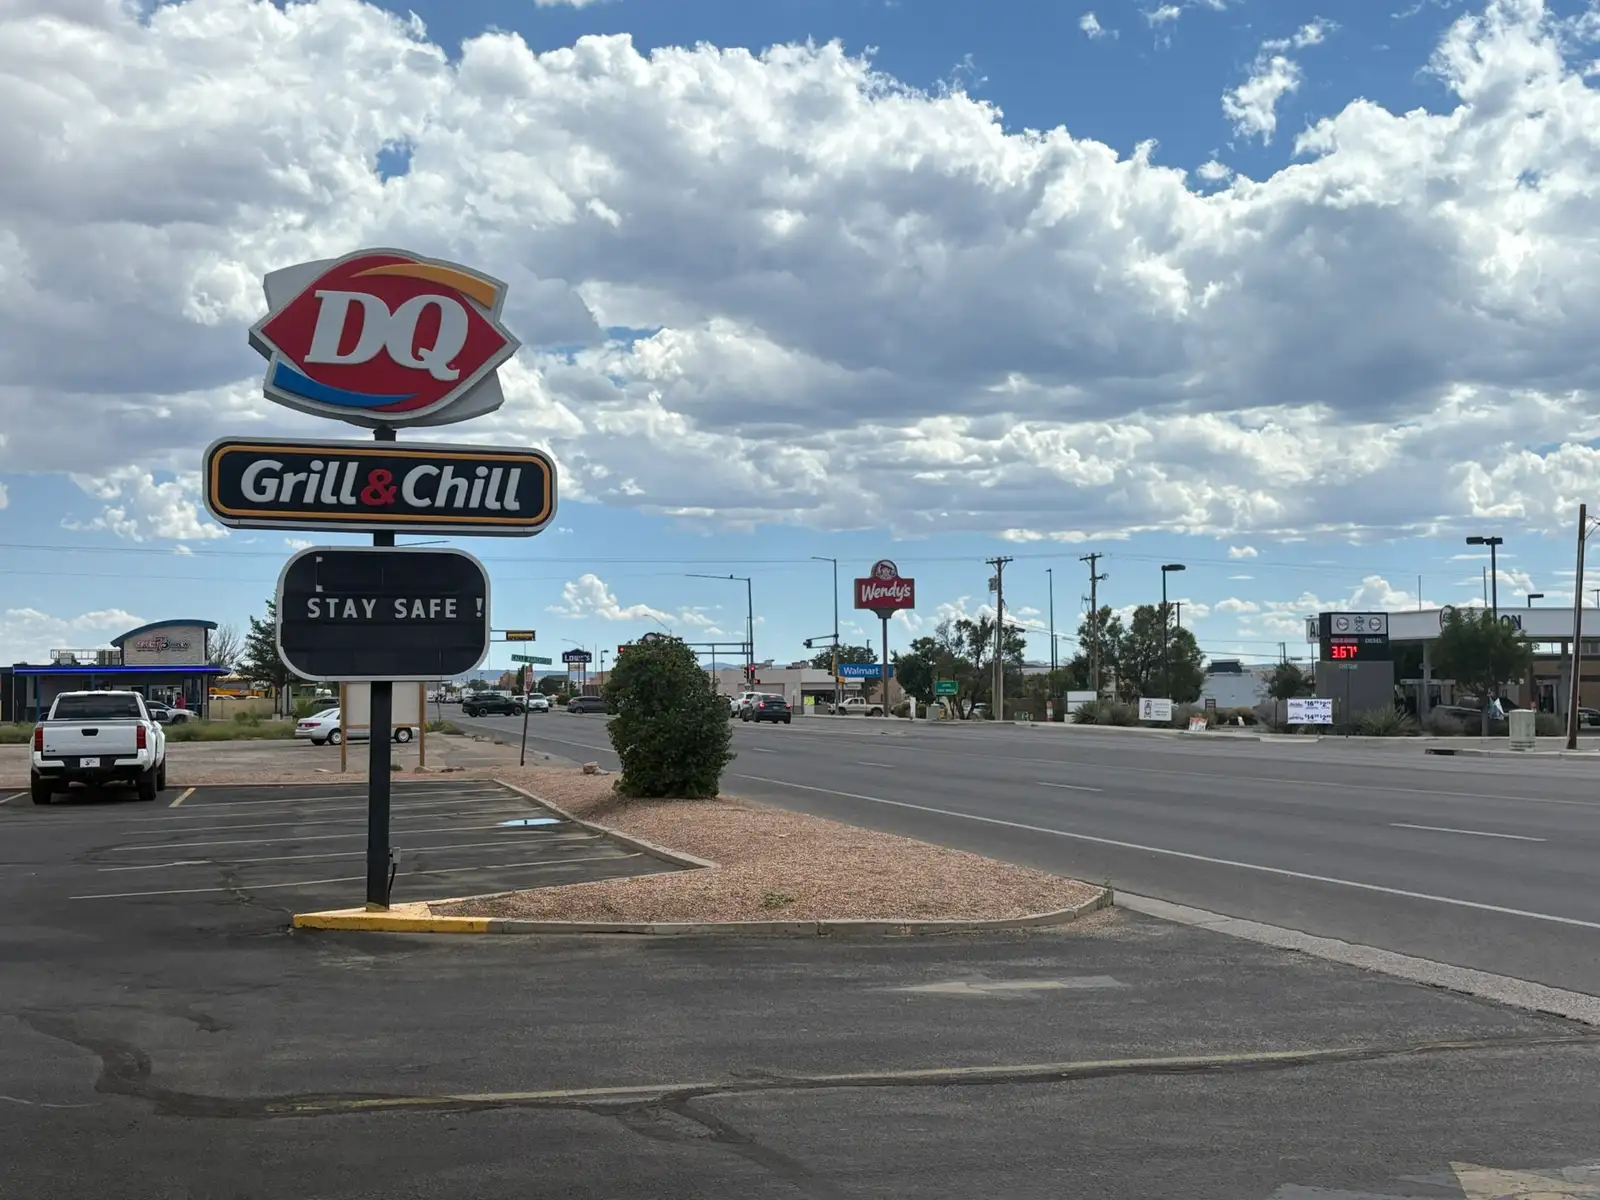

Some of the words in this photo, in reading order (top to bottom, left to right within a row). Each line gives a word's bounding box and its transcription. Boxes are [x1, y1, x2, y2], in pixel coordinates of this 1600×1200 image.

[304, 290, 469, 380] DQ
[241, 459, 359, 504] Grill
[360, 469, 396, 506] &
[401, 464, 521, 511] Chill
[862, 581, 911, 602] Wendy's
[307, 598, 378, 619] STAY
[395, 598, 458, 619] SAFE
[1309, 621, 1321, 638] AL
[1500, 614, 1522, 631] ON
[843, 666, 880, 676] Walmart
